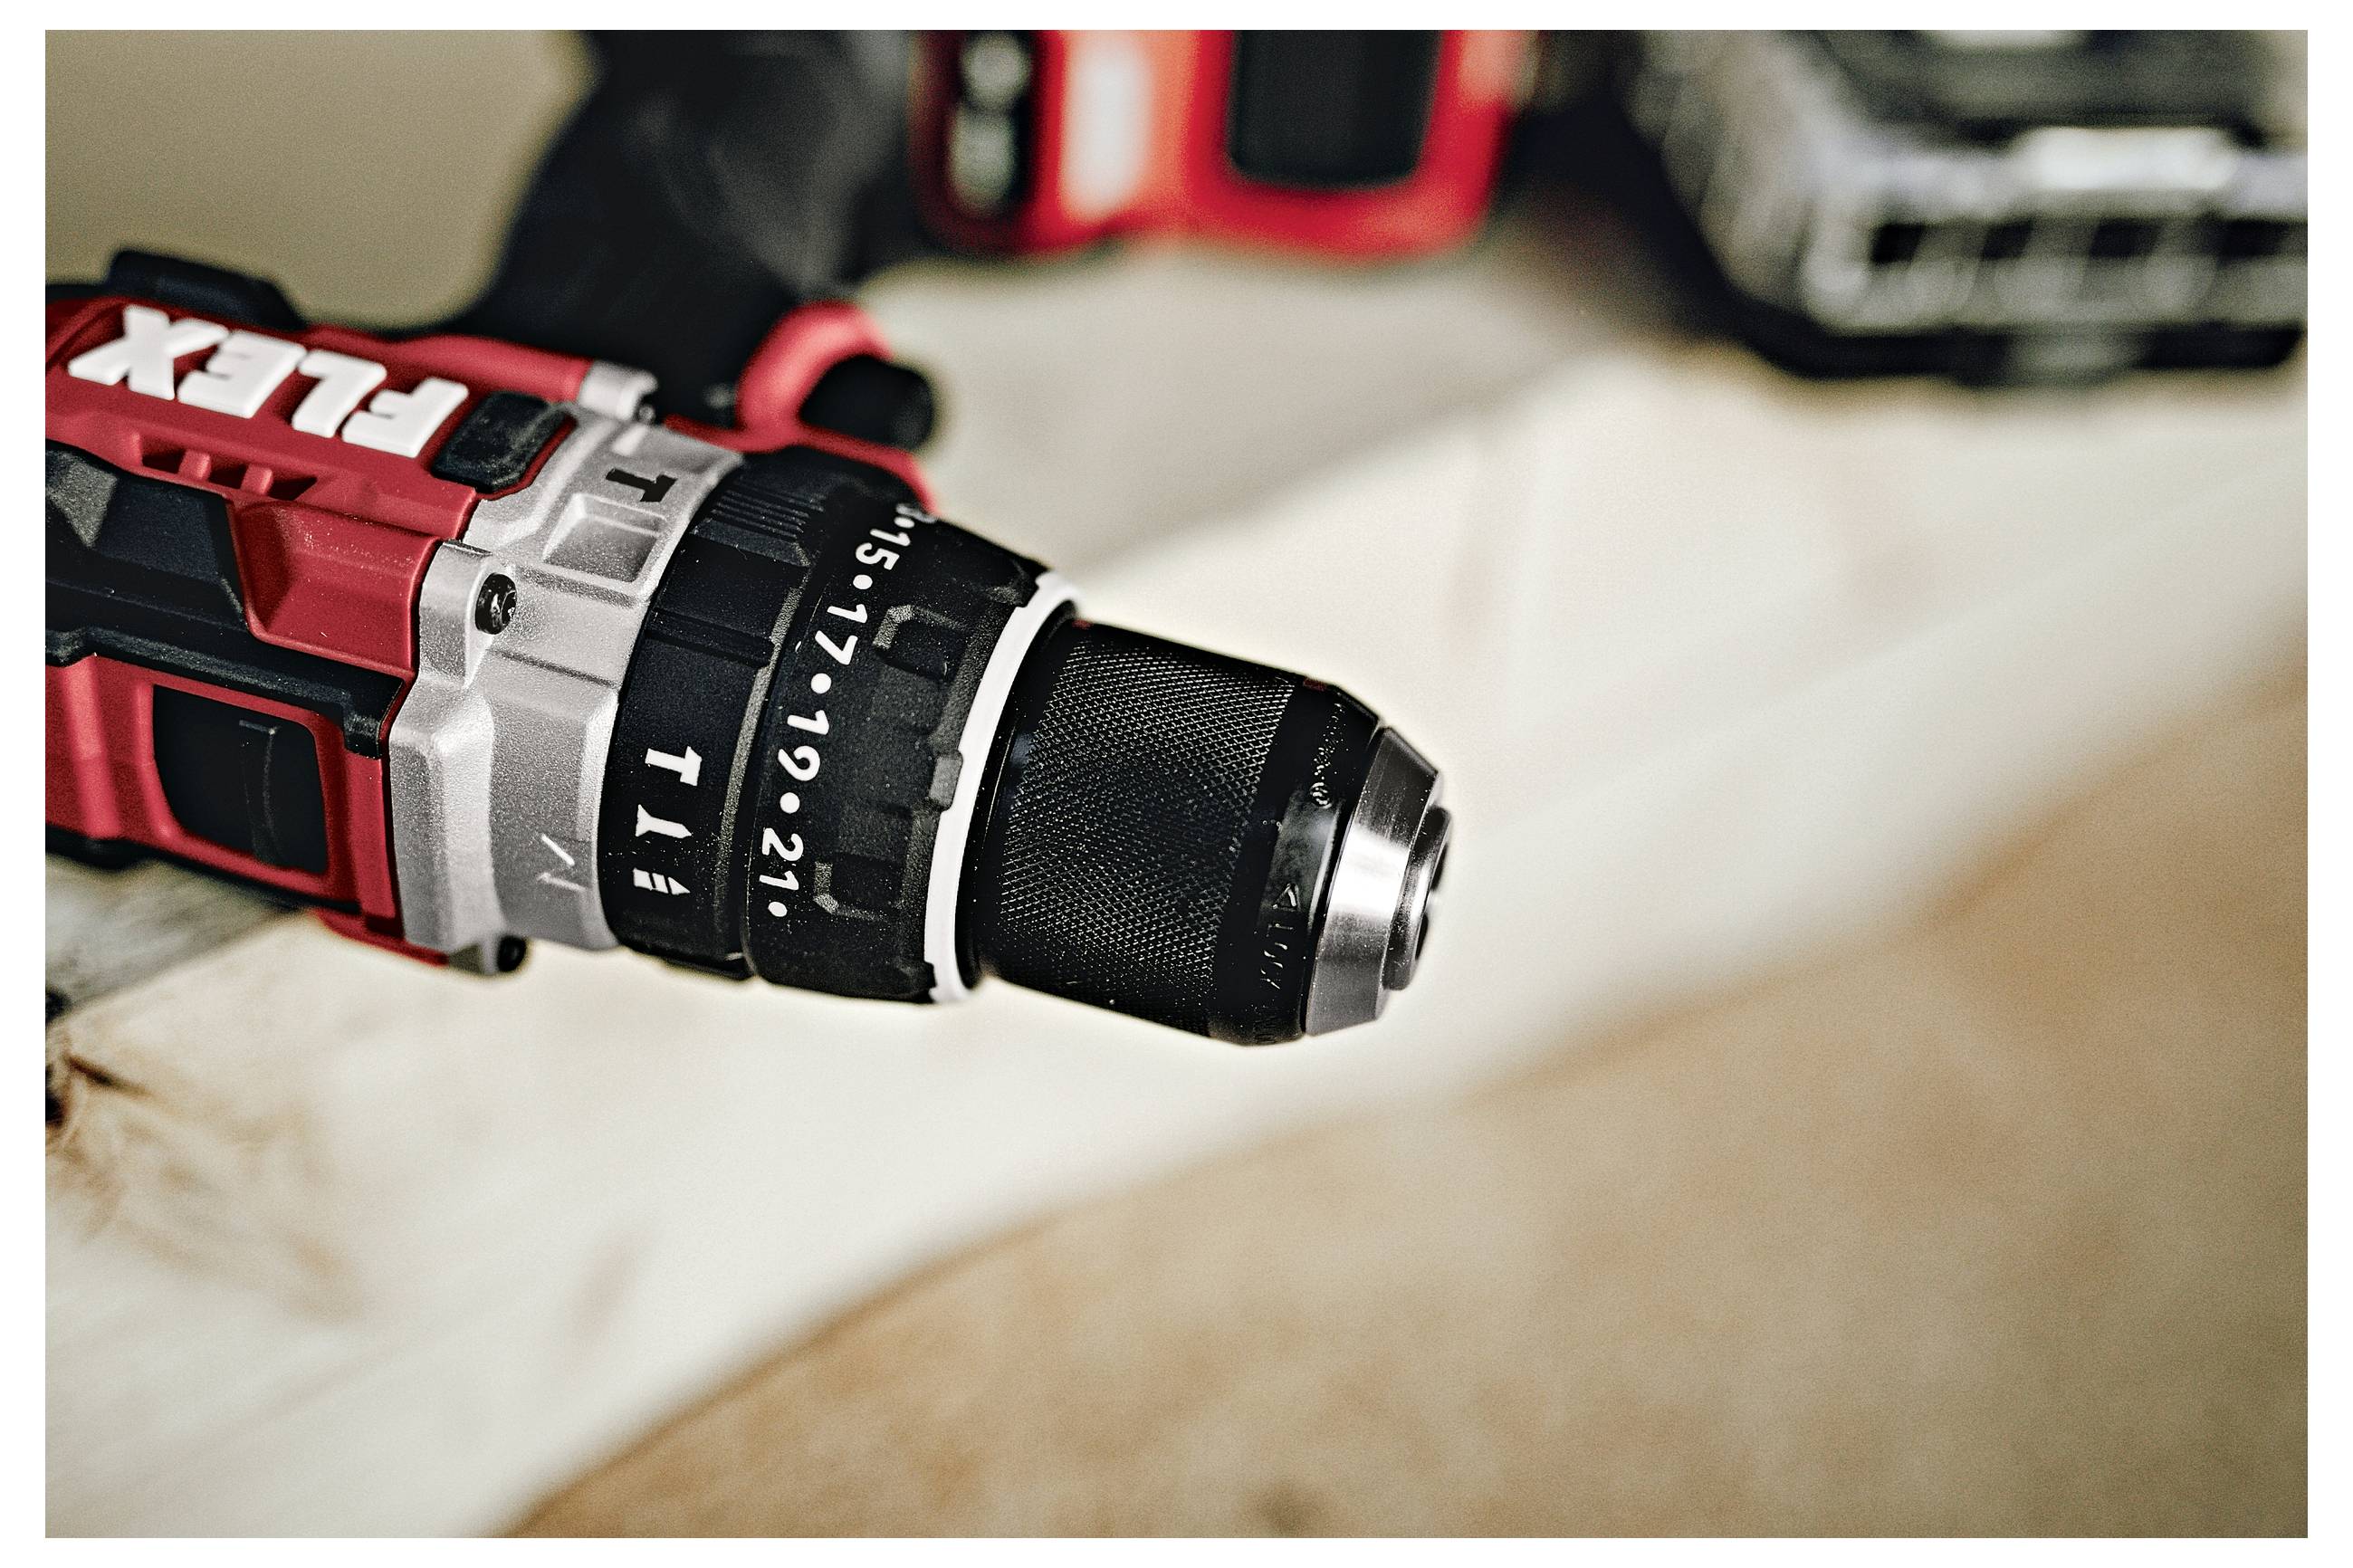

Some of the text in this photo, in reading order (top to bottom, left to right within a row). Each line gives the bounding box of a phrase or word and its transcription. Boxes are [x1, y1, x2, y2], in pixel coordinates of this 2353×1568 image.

[68, 304, 468, 459] FLEX
[760, 528, 912, 892] 15 17 19 21
